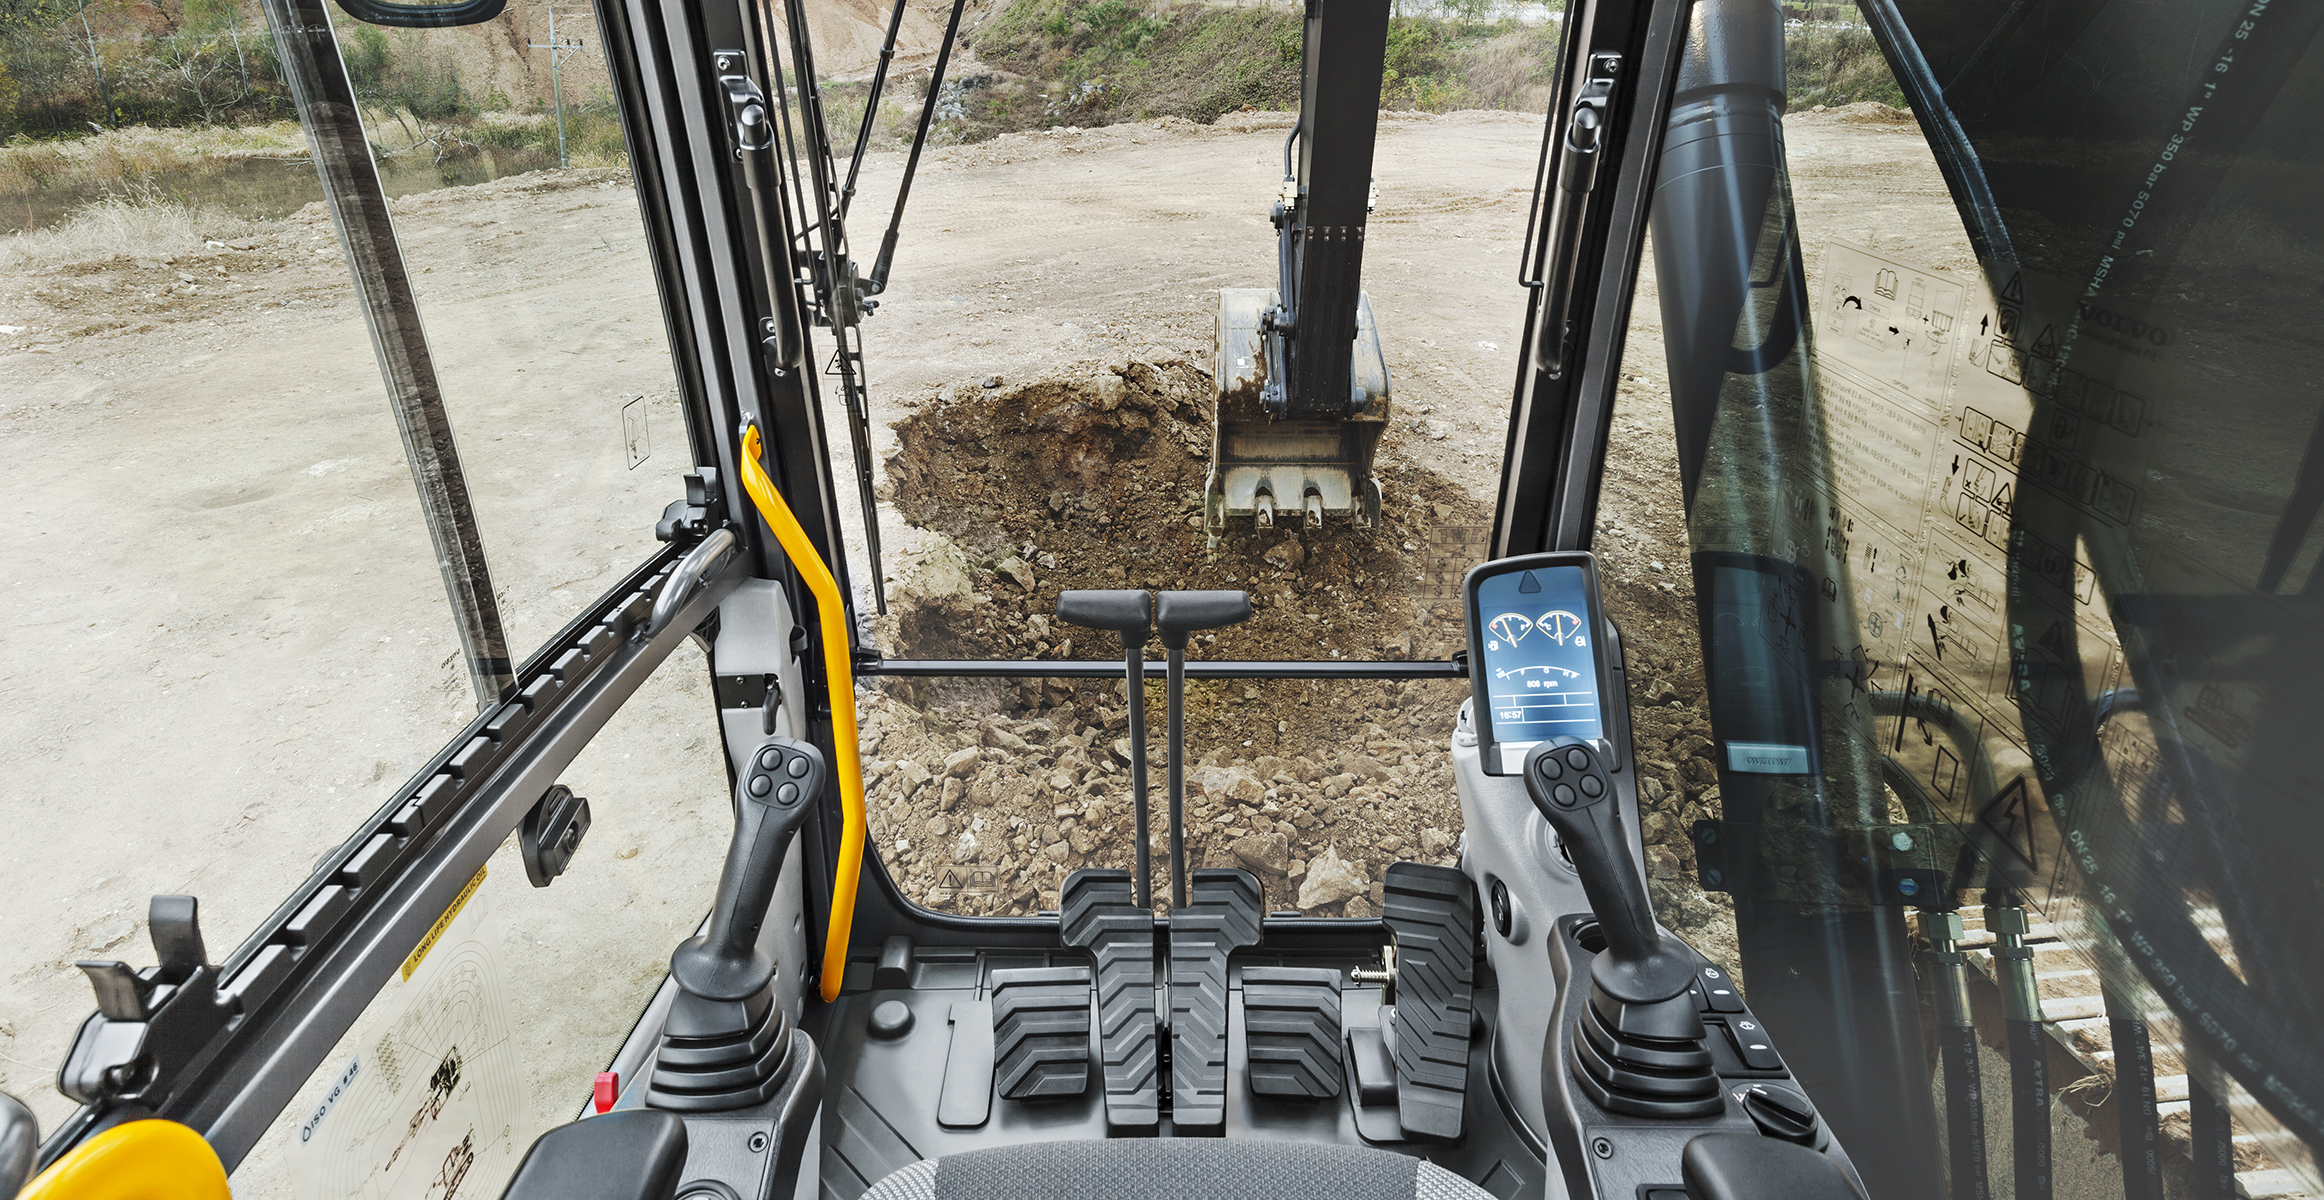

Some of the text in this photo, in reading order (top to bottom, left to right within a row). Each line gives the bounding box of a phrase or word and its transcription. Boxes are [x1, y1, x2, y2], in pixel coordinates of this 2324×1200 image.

[2235, 19, 2255, 40] 25
[2214, 47, 2234, 73] -16
[2203, 82, 2217, 99] 1"
[2181, 106, 2204, 132] WP
[2160, 133, 2184, 161] 350
[2145, 162, 2167, 189] bar
[2122, 190, 2150, 228] 5070
[2111, 230, 2126, 250] psi
[2084, 254, 2115, 297] MSHA
[2077, 300, 2168, 347] VOLVO
[1543, 680, 1559, 689] rpm
[1499, 710, 1522, 720] 16:57
[2069, 829, 2090, 856] DN
[413, 937, 431, 962] LONG
[430, 919, 445, 940] LIFE
[444, 879, 477, 923] HYDRAULIC
[476, 867, 486, 882] OIL
[1963, 1037, 1973, 1054] -12
[2135, 1040, 2147, 1061] 3/4"
[1965, 1058, 1975, 1079] 3/4"
[2139, 1065, 2148, 1082] -12
[1968, 1083, 1977, 1100] WP
[2141, 1086, 2150, 1099] 19
[310, 1105, 326, 1129] ISO
[328, 1086, 341, 1104] VG
[1969, 1100, 1979, 1119] 350
[2143, 1101, 2152, 1116] DN
[1970, 1121, 1980, 1137] bar
[1972, 1139, 1981, 1163] 5070
[1973, 1164, 1982, 1177] psi
